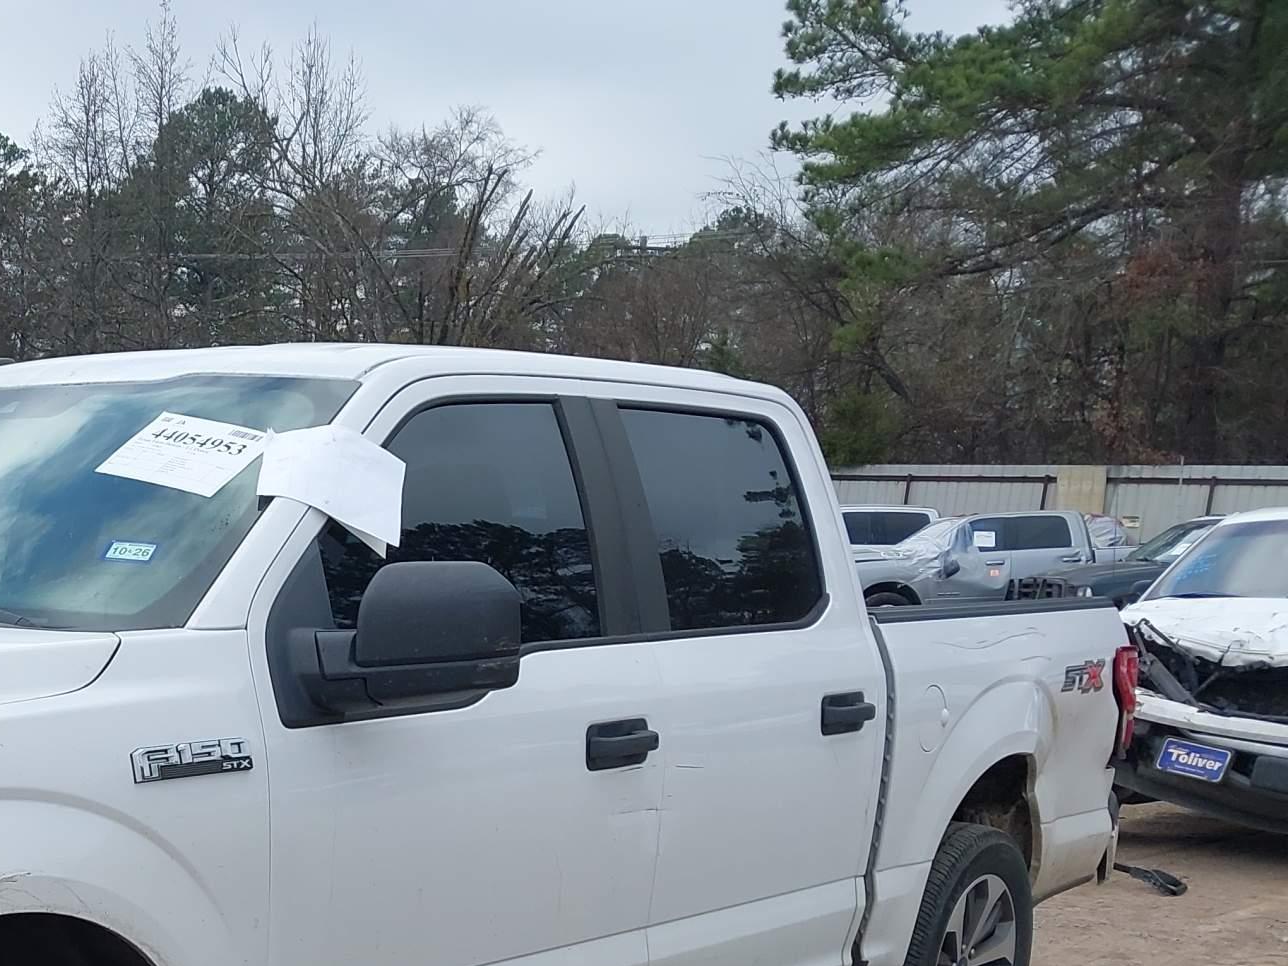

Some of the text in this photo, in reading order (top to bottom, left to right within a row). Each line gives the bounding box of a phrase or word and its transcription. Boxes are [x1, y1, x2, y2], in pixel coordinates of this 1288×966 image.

[151, 427, 248, 456] 44054953
[1061, 659, 1105, 693] STX
[221, 759, 252, 770] STX
[1167, 748, 1223, 771] Toliver
